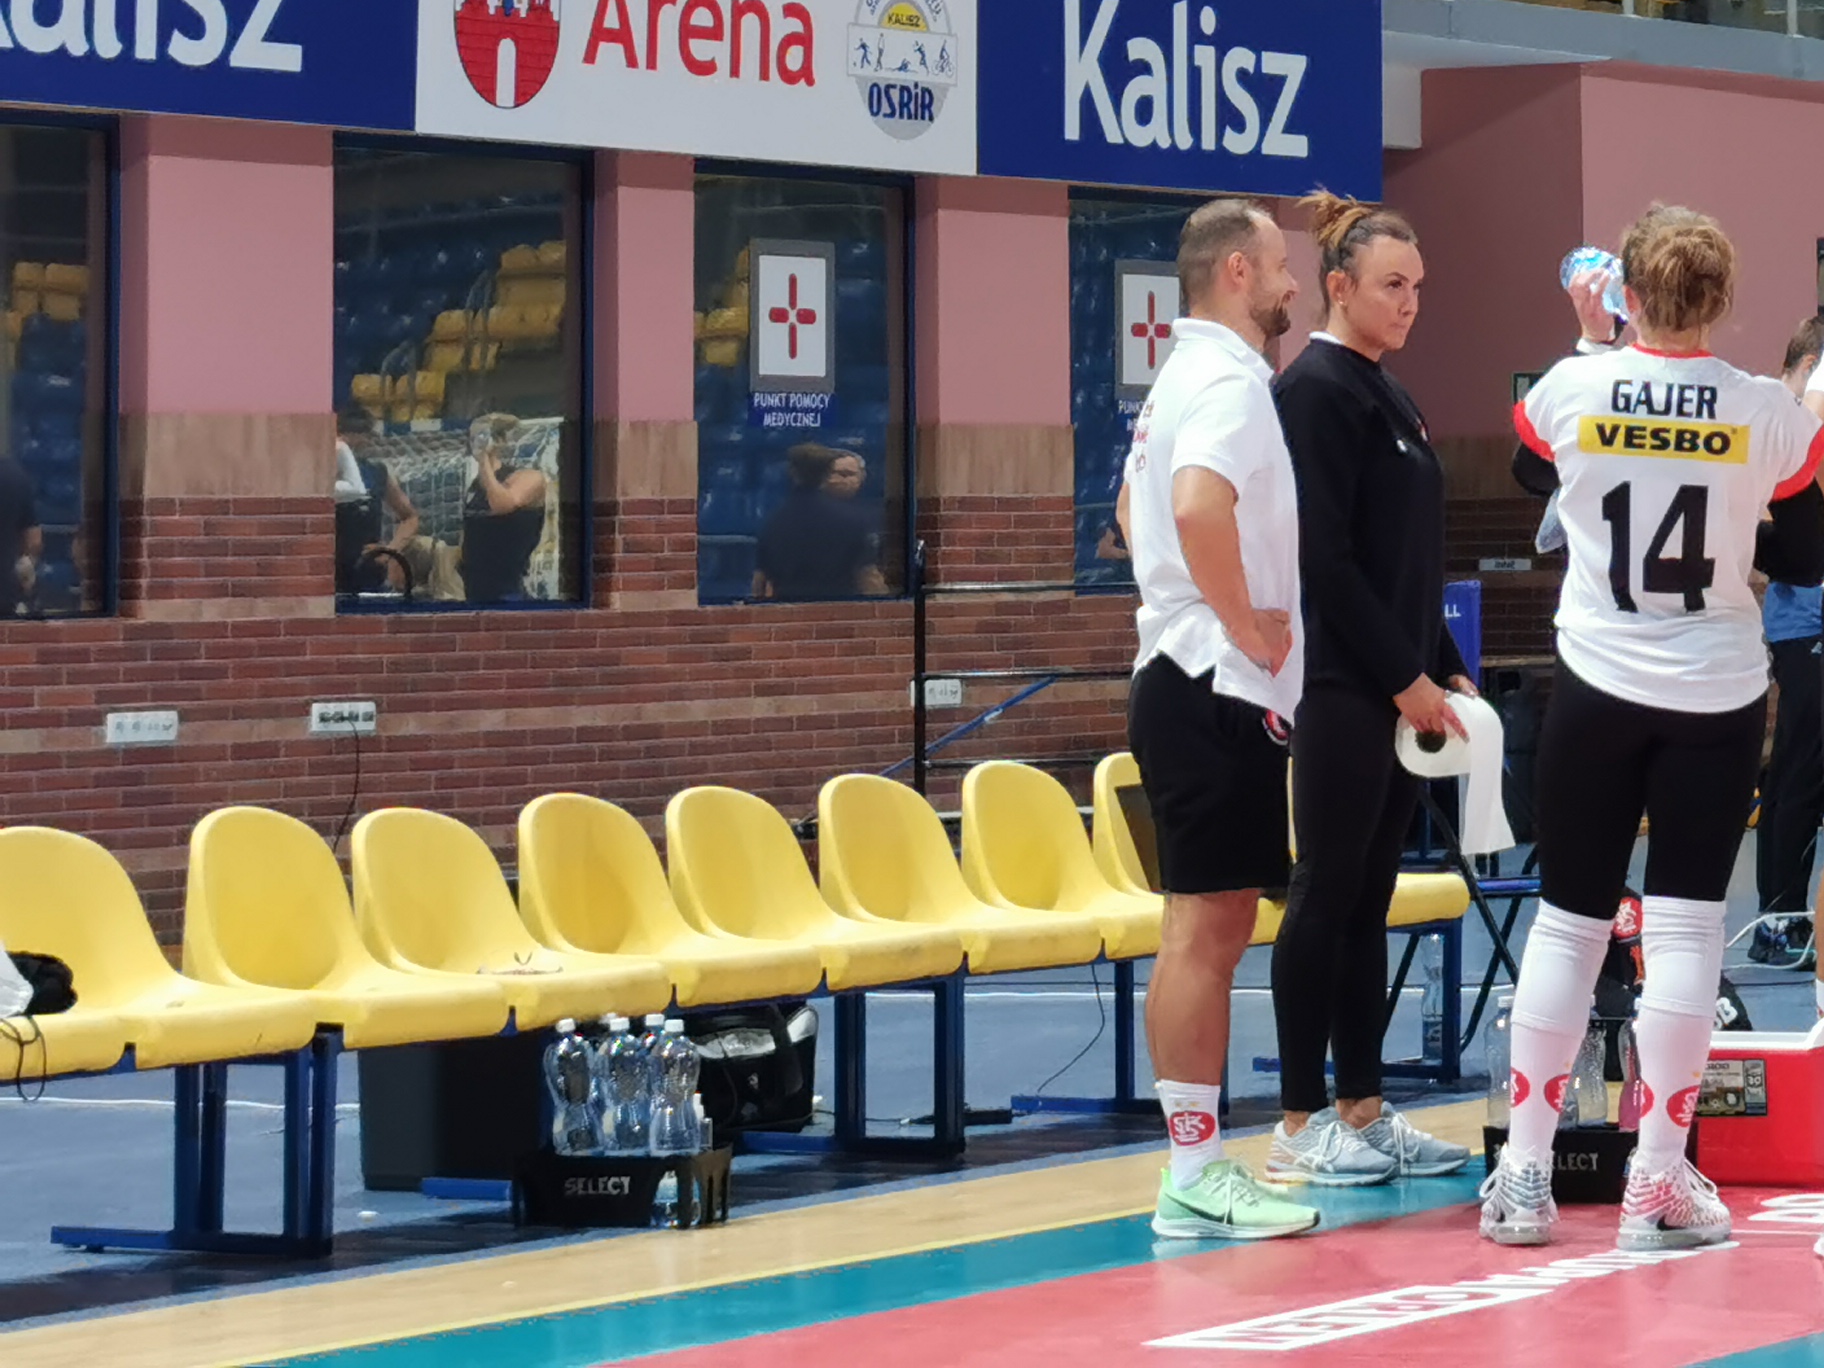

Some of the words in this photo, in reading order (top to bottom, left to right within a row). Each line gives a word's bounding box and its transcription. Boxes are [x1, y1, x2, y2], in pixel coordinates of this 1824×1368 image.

[753, 392, 787, 408] PUNKT
[789, 392, 831, 410] POMOCY
[1610, 379, 1718, 420] GAJER
[763, 412, 821, 428] MEDYCZNEJ
[1594, 422, 1732, 456] VESBO
[1601, 480, 1716, 614] 14
[1551, 1152, 1599, 1172] LECT
[563, 1175, 631, 1197] SELECT
